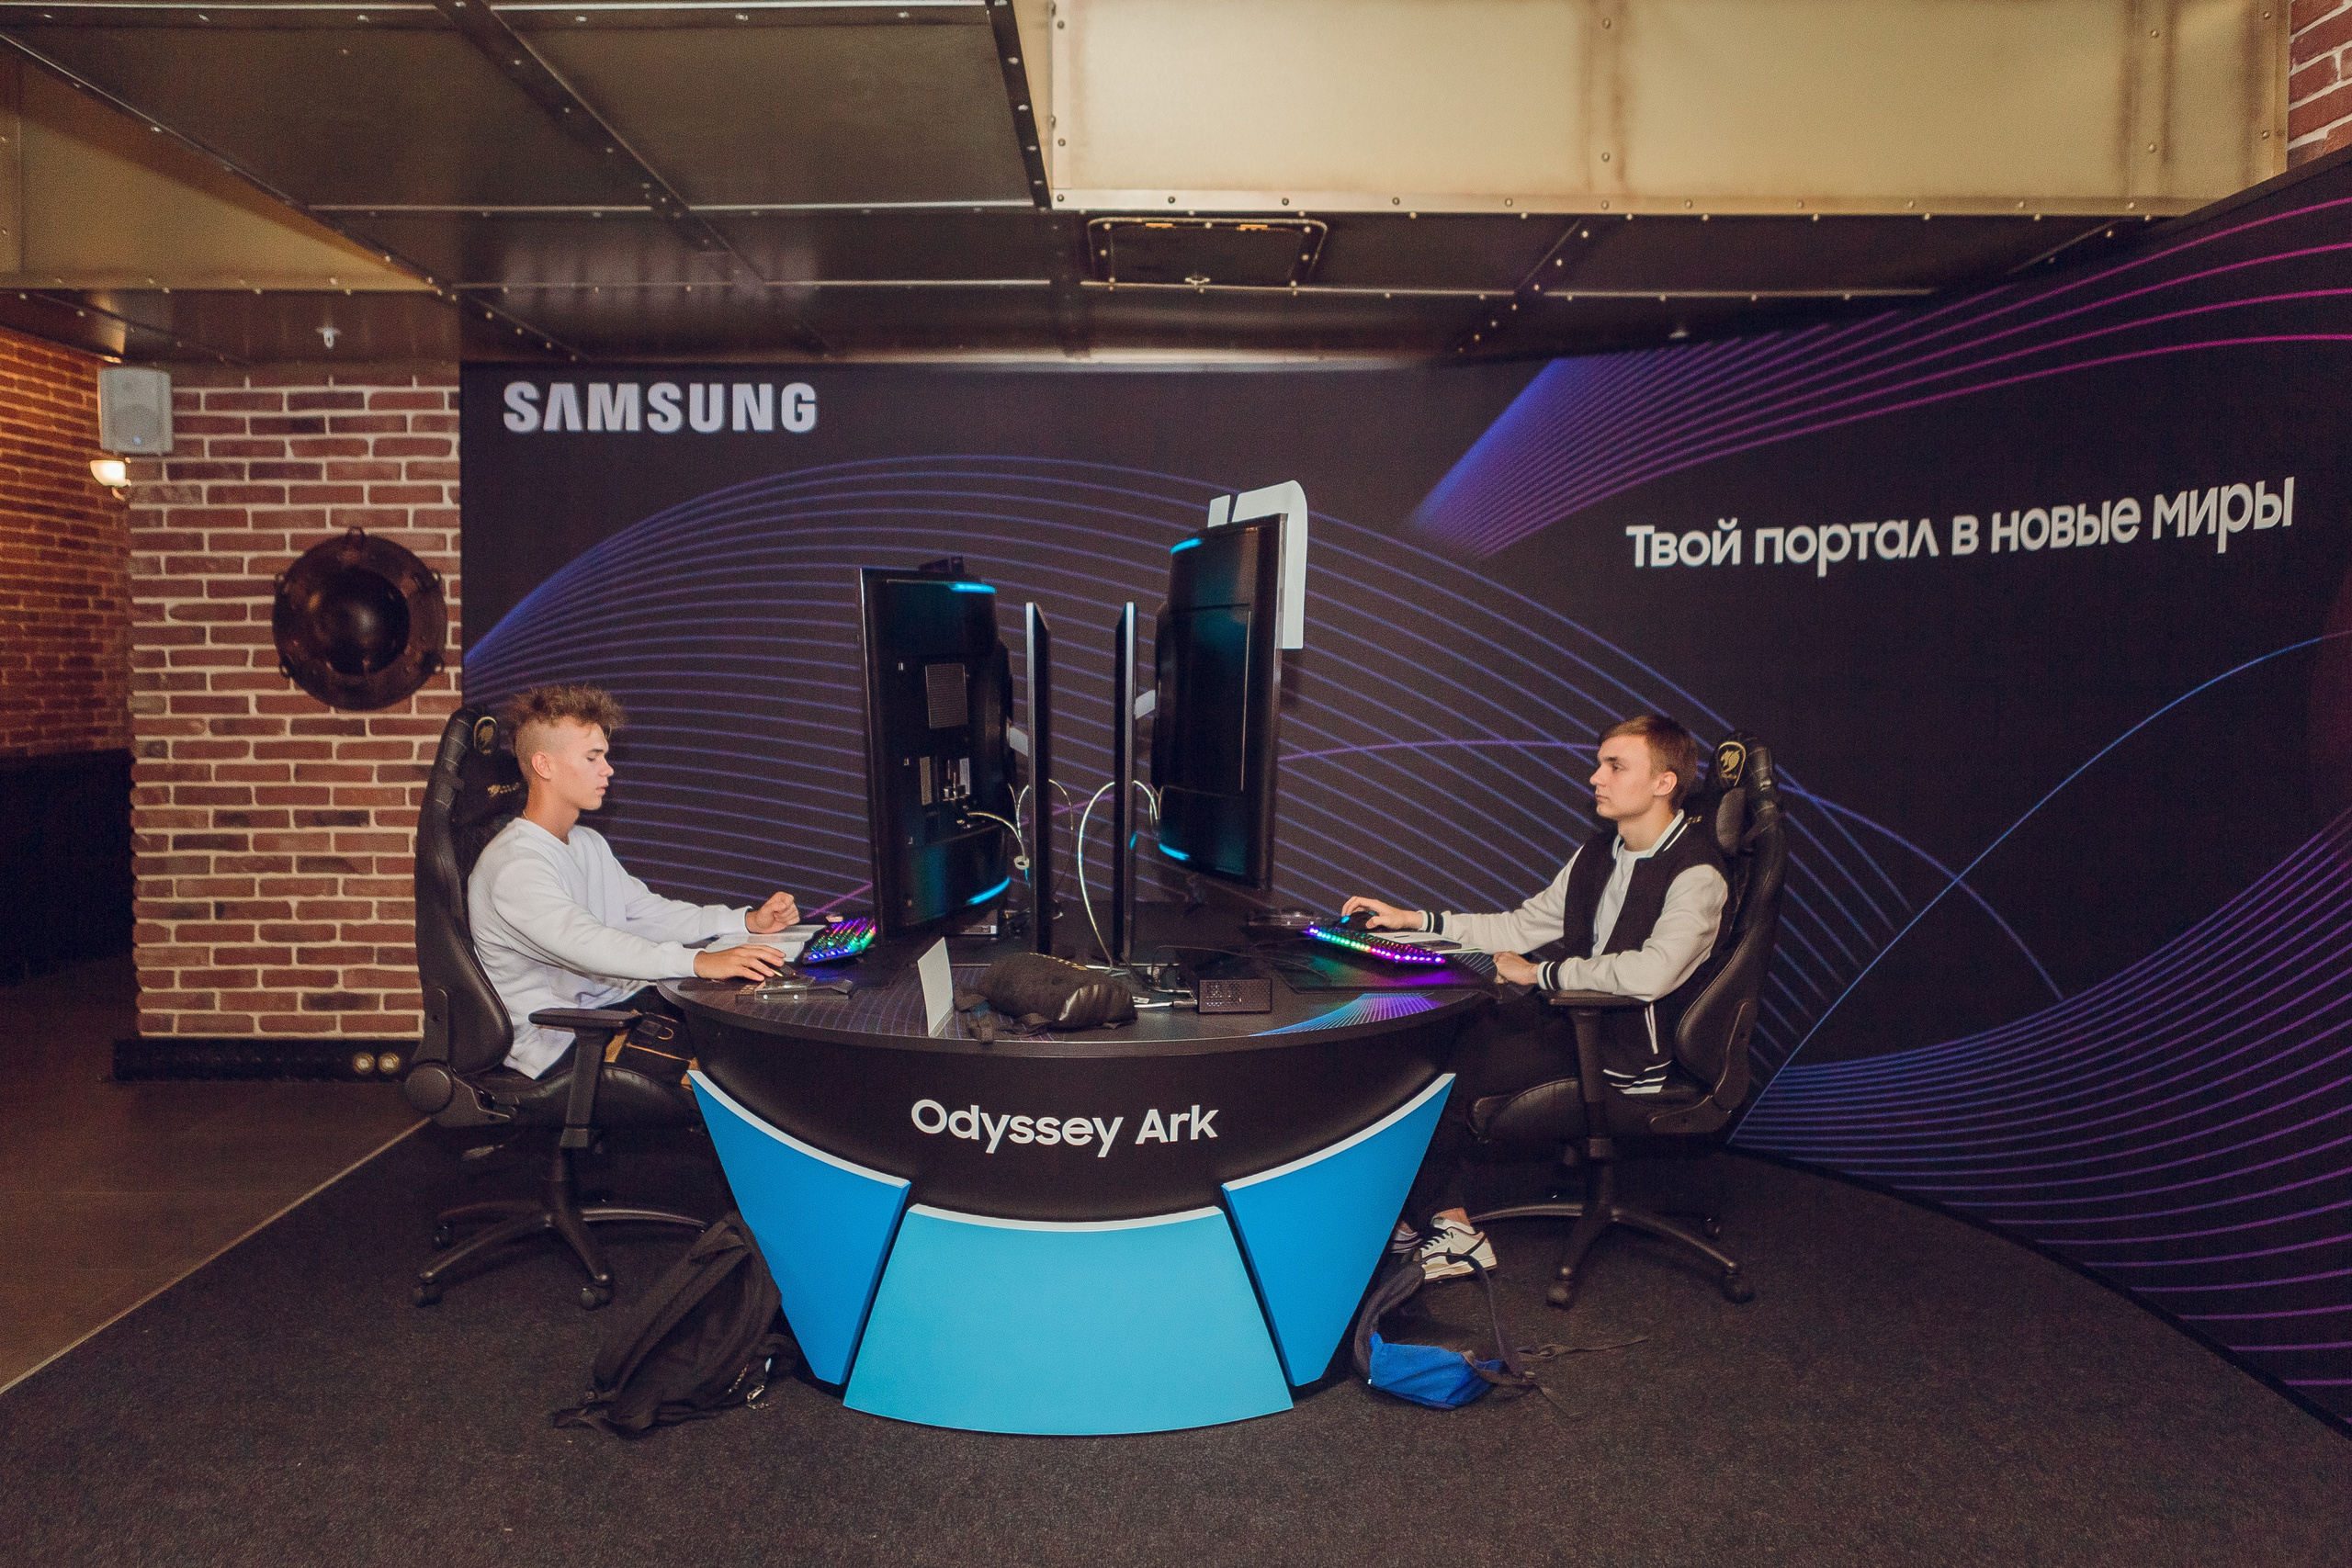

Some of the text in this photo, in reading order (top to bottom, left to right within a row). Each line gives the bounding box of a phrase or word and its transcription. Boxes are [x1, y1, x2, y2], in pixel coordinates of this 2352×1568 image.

[503, 382, 817, 434] SAMSUNG
[1625, 477, 2294, 577] Твой портал в новые миры
[910, 1098, 1219, 1158] Odyssey Ark
